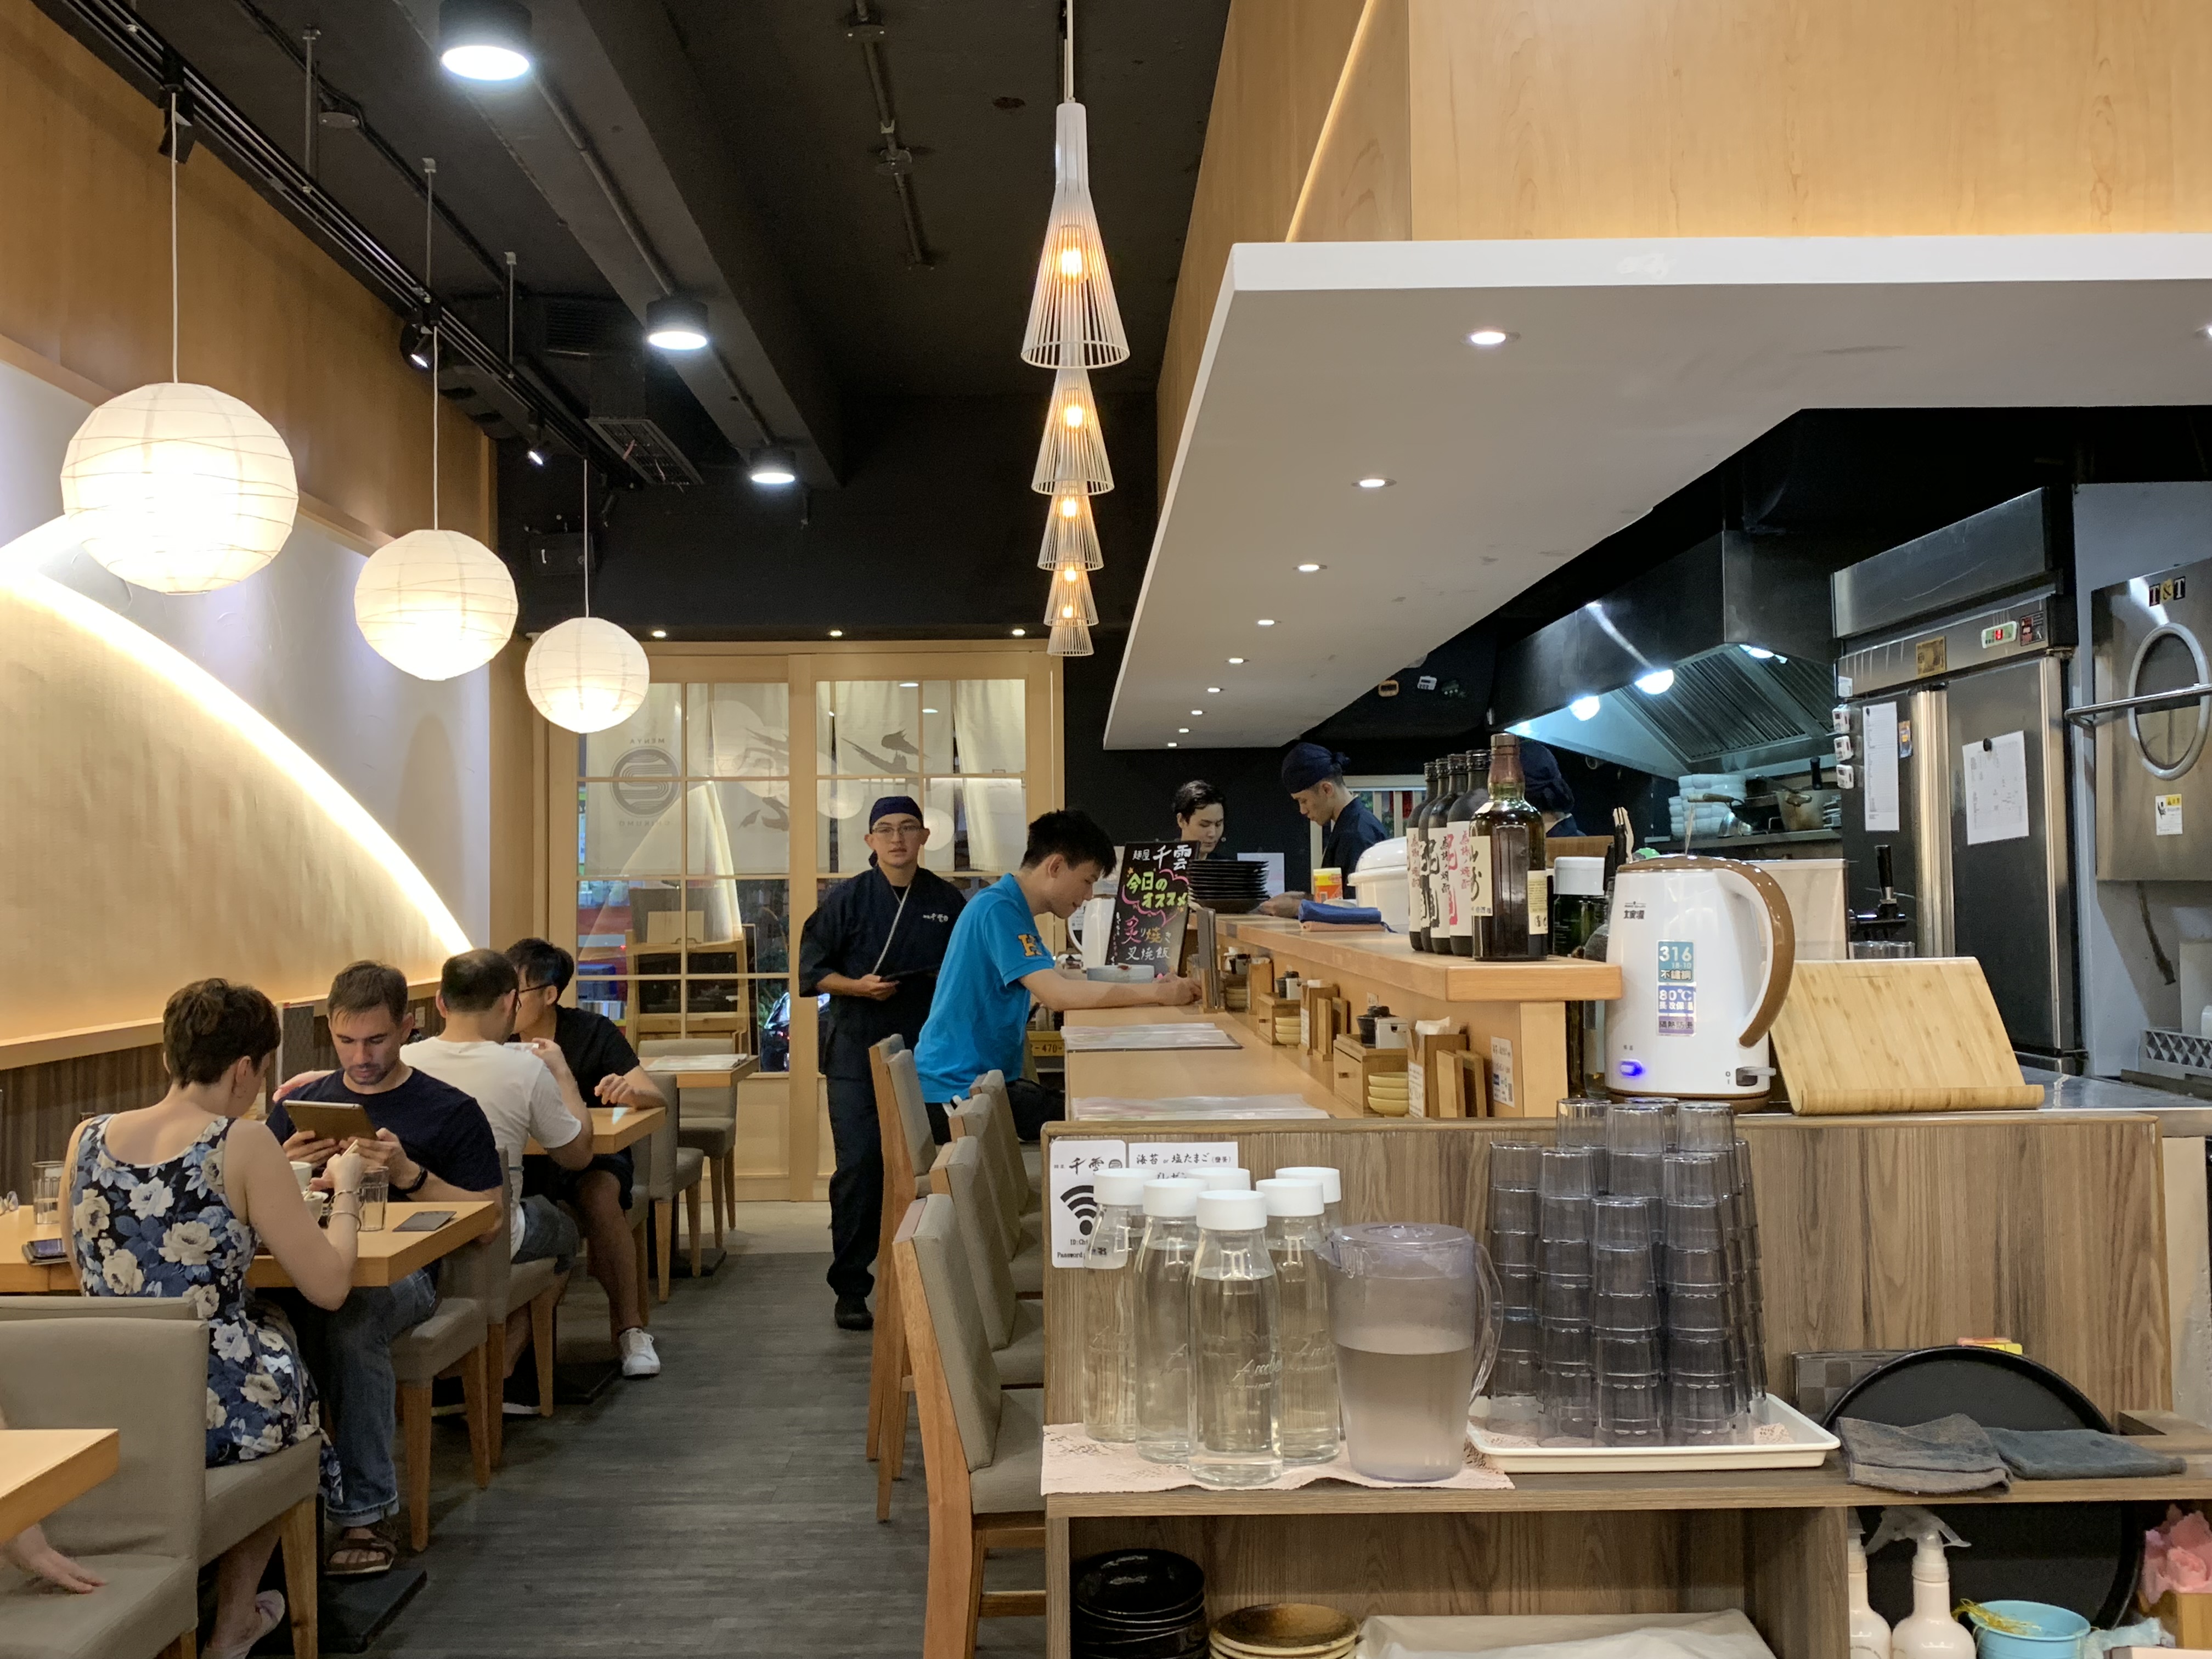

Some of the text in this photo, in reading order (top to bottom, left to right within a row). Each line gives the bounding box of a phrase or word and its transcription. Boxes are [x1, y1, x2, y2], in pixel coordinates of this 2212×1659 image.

[2149, 577, 2186, 606] T&T
[1153, 845, 1192, 871] 千雲
[1126, 871, 1168, 894] 今日の
[1142, 892, 1188, 909] オススメ
[1659, 946, 1692, 962] 316
[1136, 1154, 1159, 1165] 海苔
[1171, 1153, 1210, 1164] 塩たまご
